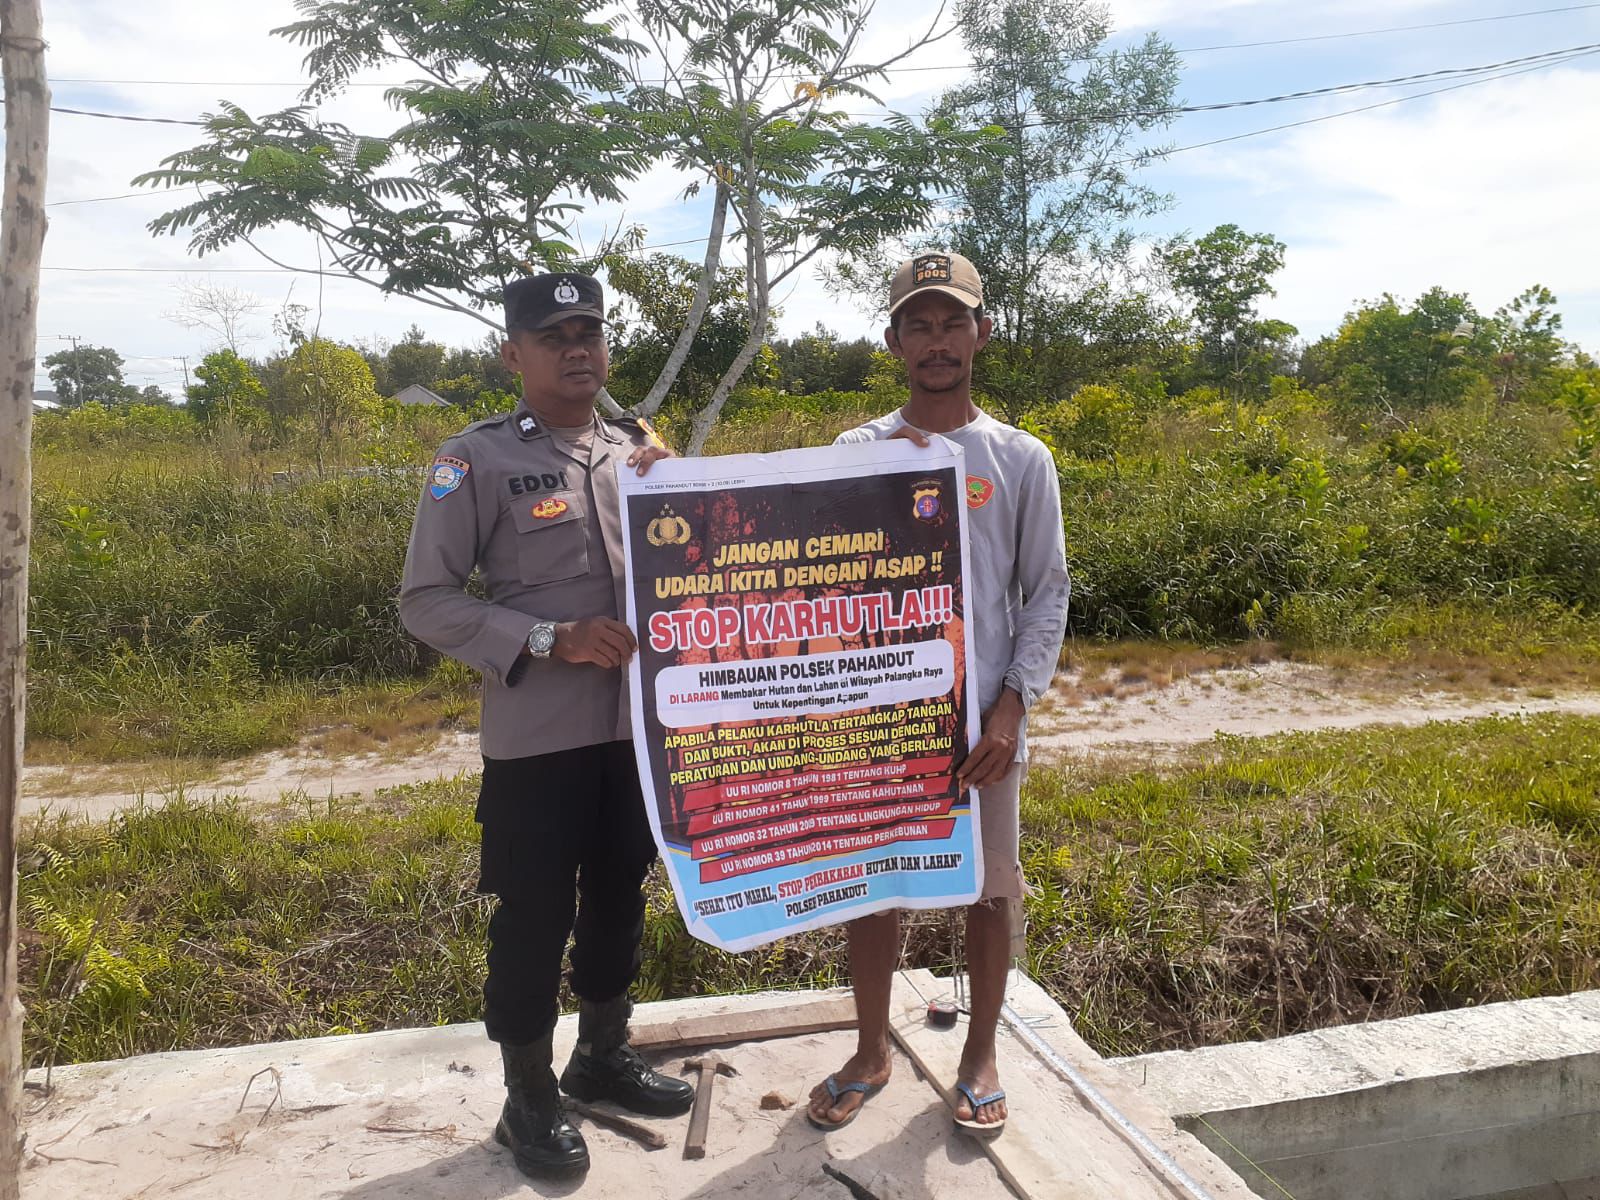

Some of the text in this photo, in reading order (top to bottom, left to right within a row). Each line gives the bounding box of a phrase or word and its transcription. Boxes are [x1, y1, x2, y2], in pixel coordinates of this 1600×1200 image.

[508, 471, 568, 496] EDDI
[713, 529, 884, 568] JANGAN CEMARI
[655, 573, 724, 599] UDARA
[730, 569, 778, 592] KITA
[784, 560, 868, 588] DENGAN
[874, 554, 927, 579] ASAP
[648, 584, 953, 652] STOP KARHUTLA!!!
[669, 667, 943, 705] DI LARANG Membakar Hutan dan Lahan di Wilayah Palangka Raya
[699, 650, 915, 688] HIMBAUAN POLSEK PAHANDUT
[753, 699, 780, 710] Untuk
[781, 694, 835, 710] Kepentingan
[664, 702, 952, 750] APABILA PELAKU KARHUTLA TERTANGKAP TANGAN
[684, 722, 936, 765] DAN BUKTI, AKAN DI PROSES SESUAI DENGAN
[670, 736, 952, 785] PERATURAN DAN UNDANG-UNDANG YANG BERLAKU
[726, 764, 907, 798] UU RI NOMOR 8 TAHUN 1981 TENTANG KUHP
[712, 783, 925, 824] UU RI NOMOR 41 TAHUN 1999 TENTANG KAHUTANAN
[701, 841, 714, 852] UU
[715, 839, 725, 850] RI
[726, 831, 756, 846] NOMOR
[757, 829, 768, 840] 32
[768, 823, 799, 837] TAHUN
[816, 814, 857, 827] TENTANG
[858, 805, 914, 823] LINGKUNGAN
[915, 802, 941, 813] HIDUP
[721, 862, 734, 873] UU
[742, 853, 774, 869] NOMOR
[774, 850, 786, 860] 39
[833, 835, 873, 849] TENTANG
[874, 825, 929, 842] PERKEBUNAN
[726, 892, 744, 911] ITU
[778, 880, 803, 898] STOP
[865, 857, 902, 876] HUTAN
[900, 856, 921, 870] DAN
[817, 883, 868, 907] PAHANDUT
